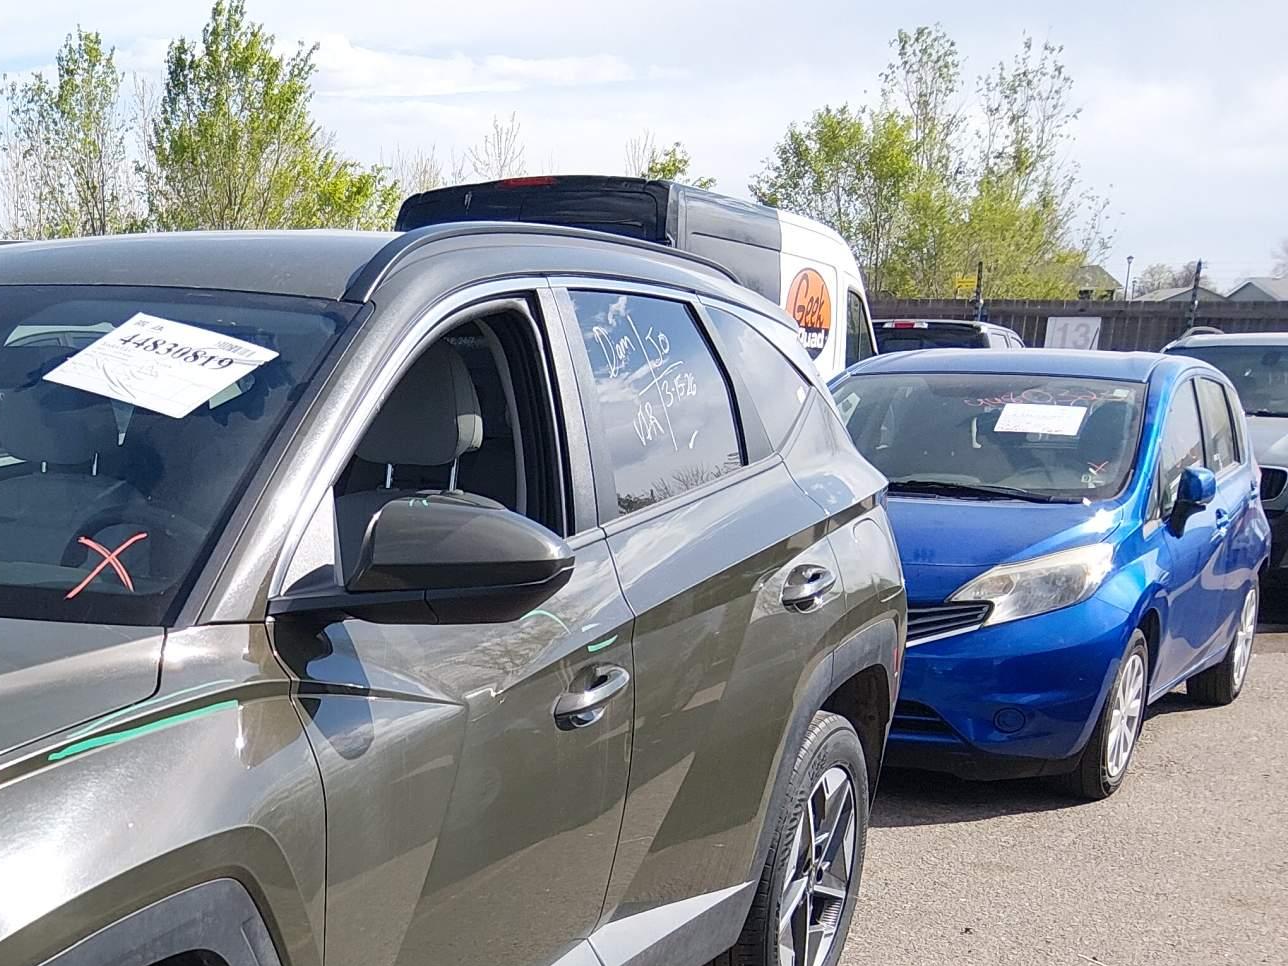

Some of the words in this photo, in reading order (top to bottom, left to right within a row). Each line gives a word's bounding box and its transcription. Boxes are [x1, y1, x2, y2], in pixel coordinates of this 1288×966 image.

[793, 273, 825, 329] Geek
[120, 333, 234, 370] 44830819
[1055, 323, 1091, 347] 13
